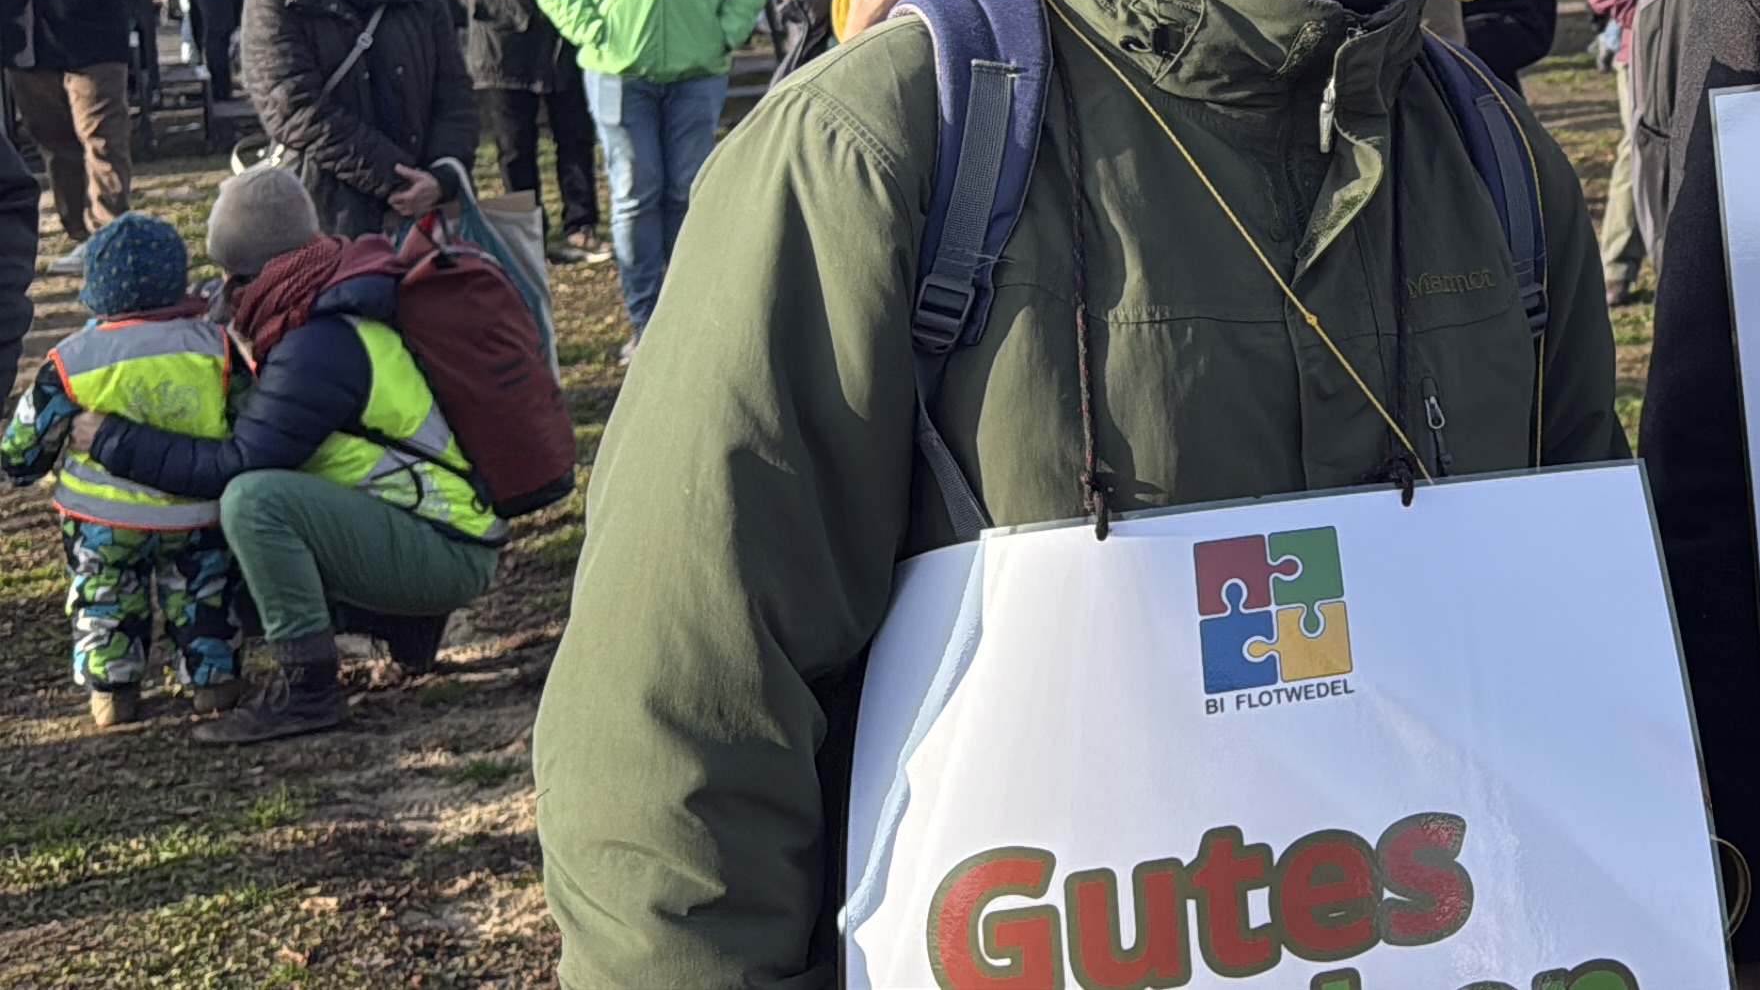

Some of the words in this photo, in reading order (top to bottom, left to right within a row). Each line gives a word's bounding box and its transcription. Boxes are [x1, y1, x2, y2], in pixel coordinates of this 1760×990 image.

[1406, 269, 1496, 300] Marmot
[1204, 696, 1225, 715] BI
[1234, 678, 1356, 711] FLOTWEDEL
[926, 811, 1475, 990] Gutes
